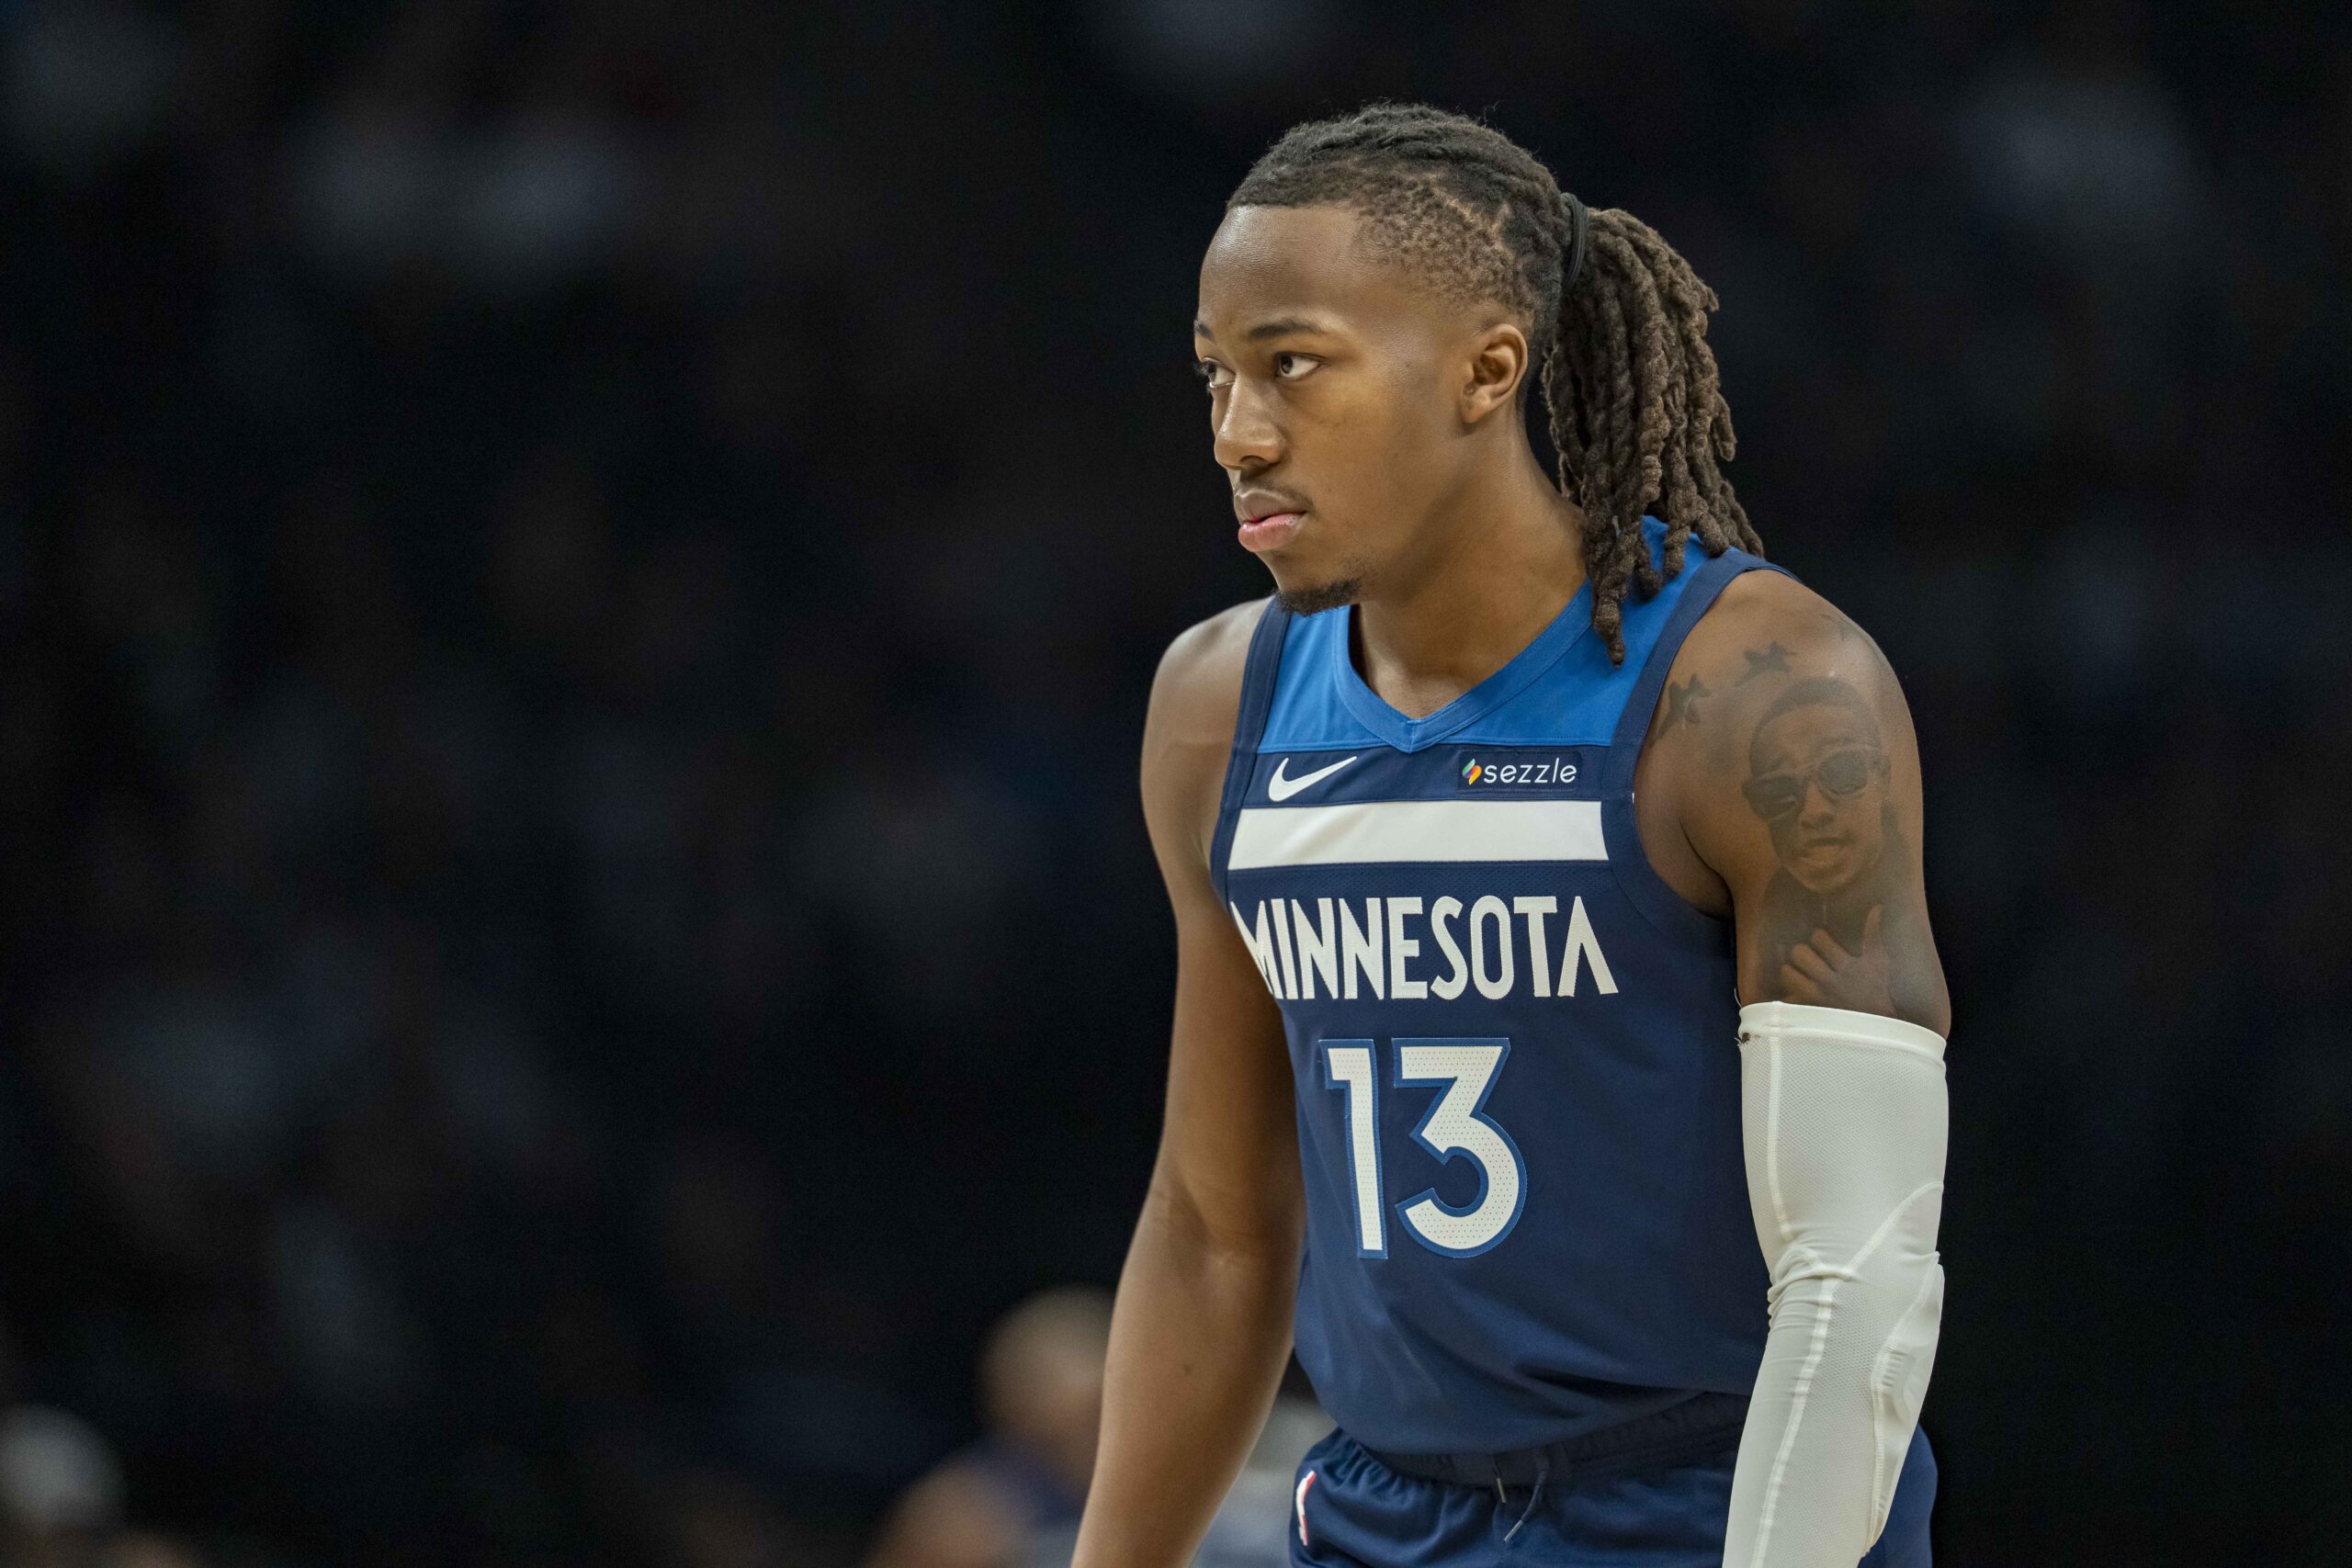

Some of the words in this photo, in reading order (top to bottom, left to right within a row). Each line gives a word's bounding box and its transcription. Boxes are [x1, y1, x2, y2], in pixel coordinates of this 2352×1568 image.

[1483, 757, 1577, 784] sezzle
[1229, 895, 1620, 1000] MINNESOTA
[1317, 1037, 1527, 1259] 13
